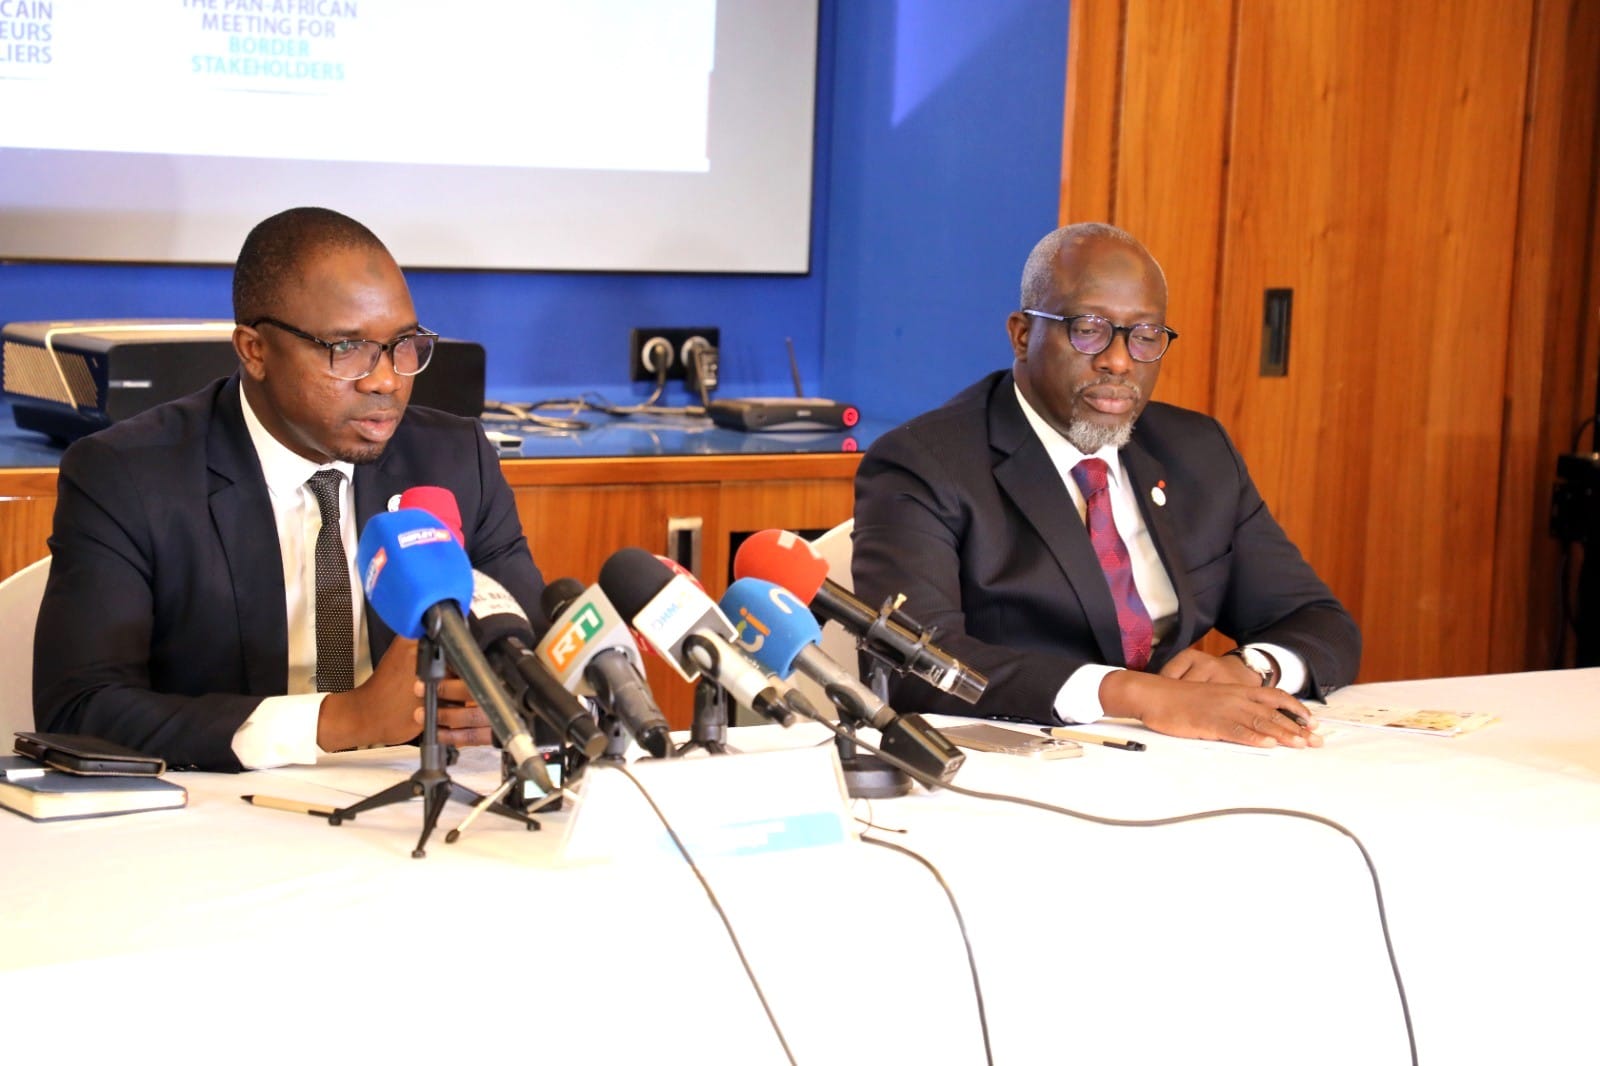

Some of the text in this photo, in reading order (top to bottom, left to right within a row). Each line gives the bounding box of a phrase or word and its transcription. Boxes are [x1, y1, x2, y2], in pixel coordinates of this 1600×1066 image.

[0, 0, 53, 20] CAIN
[225, 0, 358, 18] PAN-AFRICAN
[0, 20, 53, 42] EURS
[202, 13, 336, 39] MEETING FOR
[228, 36, 310, 57] BORDER
[191, 55, 345, 81] STAKEHOLDERS
